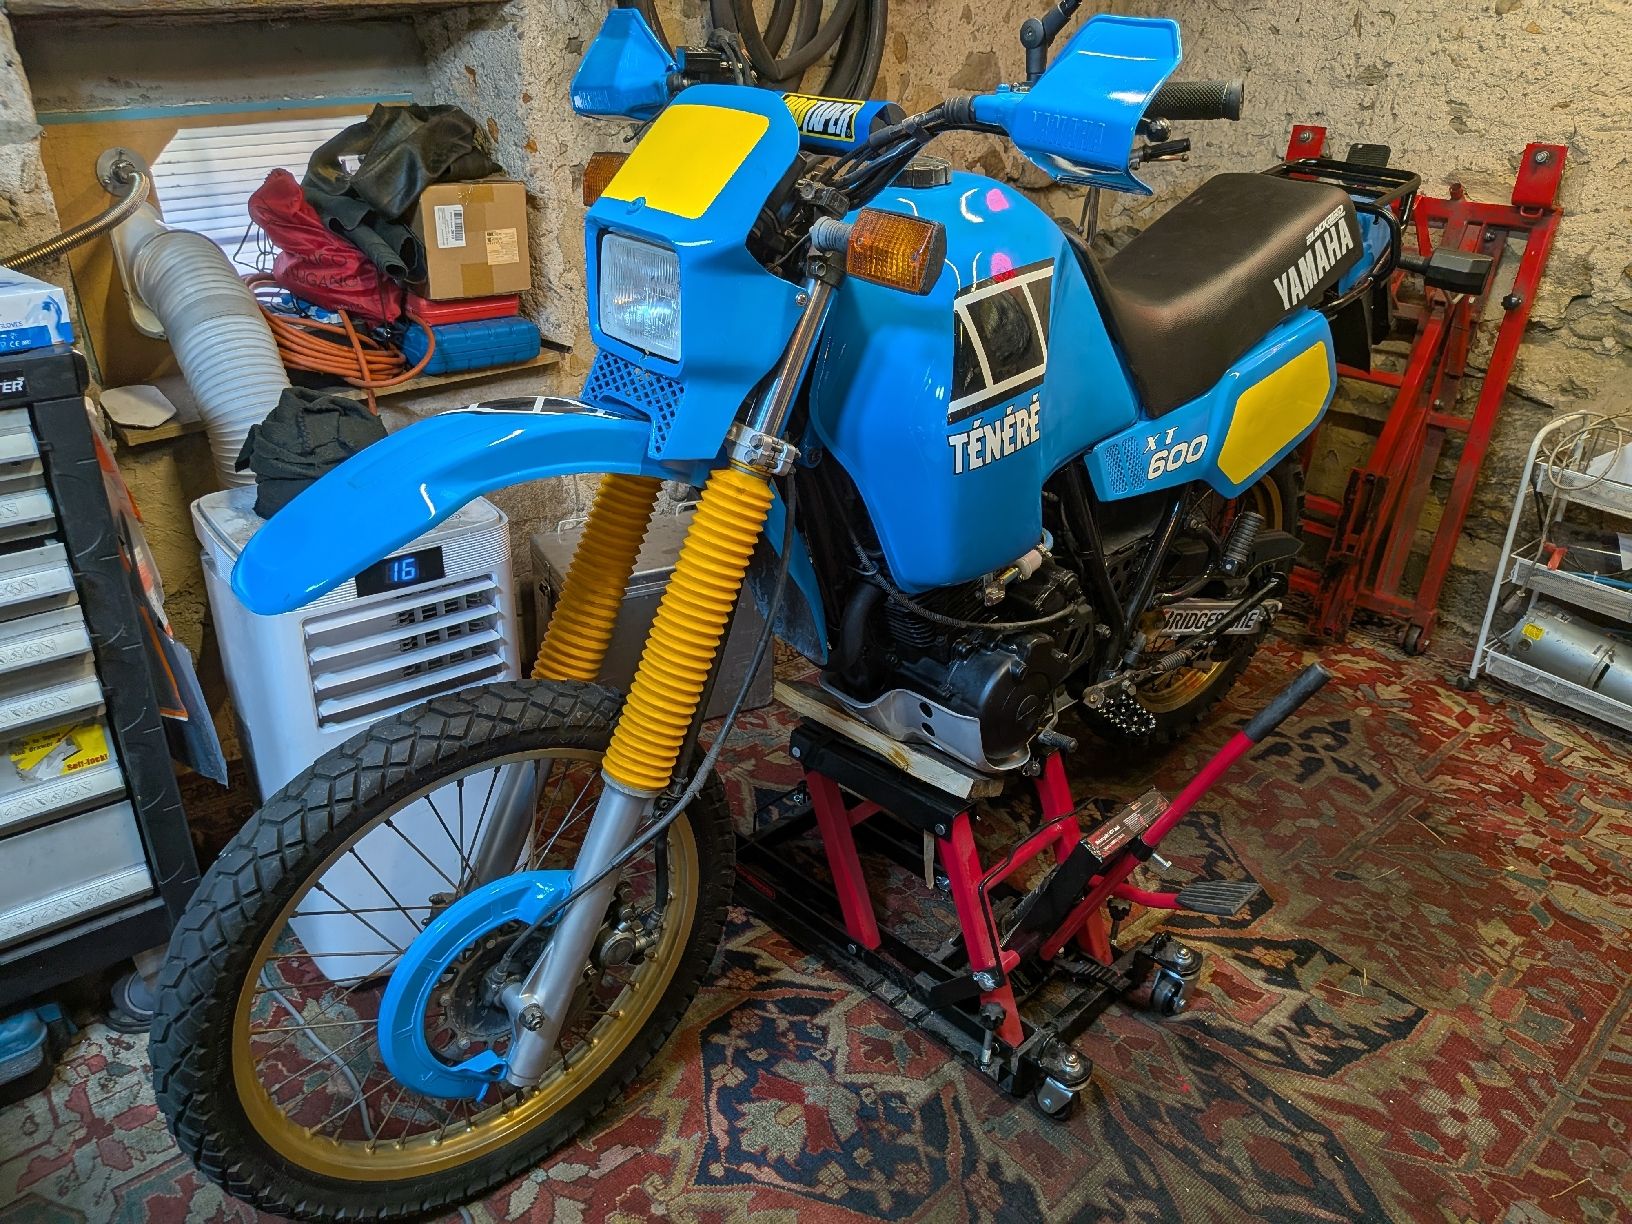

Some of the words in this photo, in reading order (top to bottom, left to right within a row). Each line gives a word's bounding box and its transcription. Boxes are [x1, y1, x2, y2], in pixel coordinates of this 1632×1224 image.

[1272, 217, 1354, 311] YAMAHA
[0, 380, 23, 393] ER
[947, 391, 1041, 475] TÉNÉRÉ
[1142, 426, 1179, 455] XT
[1146, 433, 1209, 481] 600
[393, 557, 416, 583] 16
[1163, 609, 1258, 630] BRIDGEE
